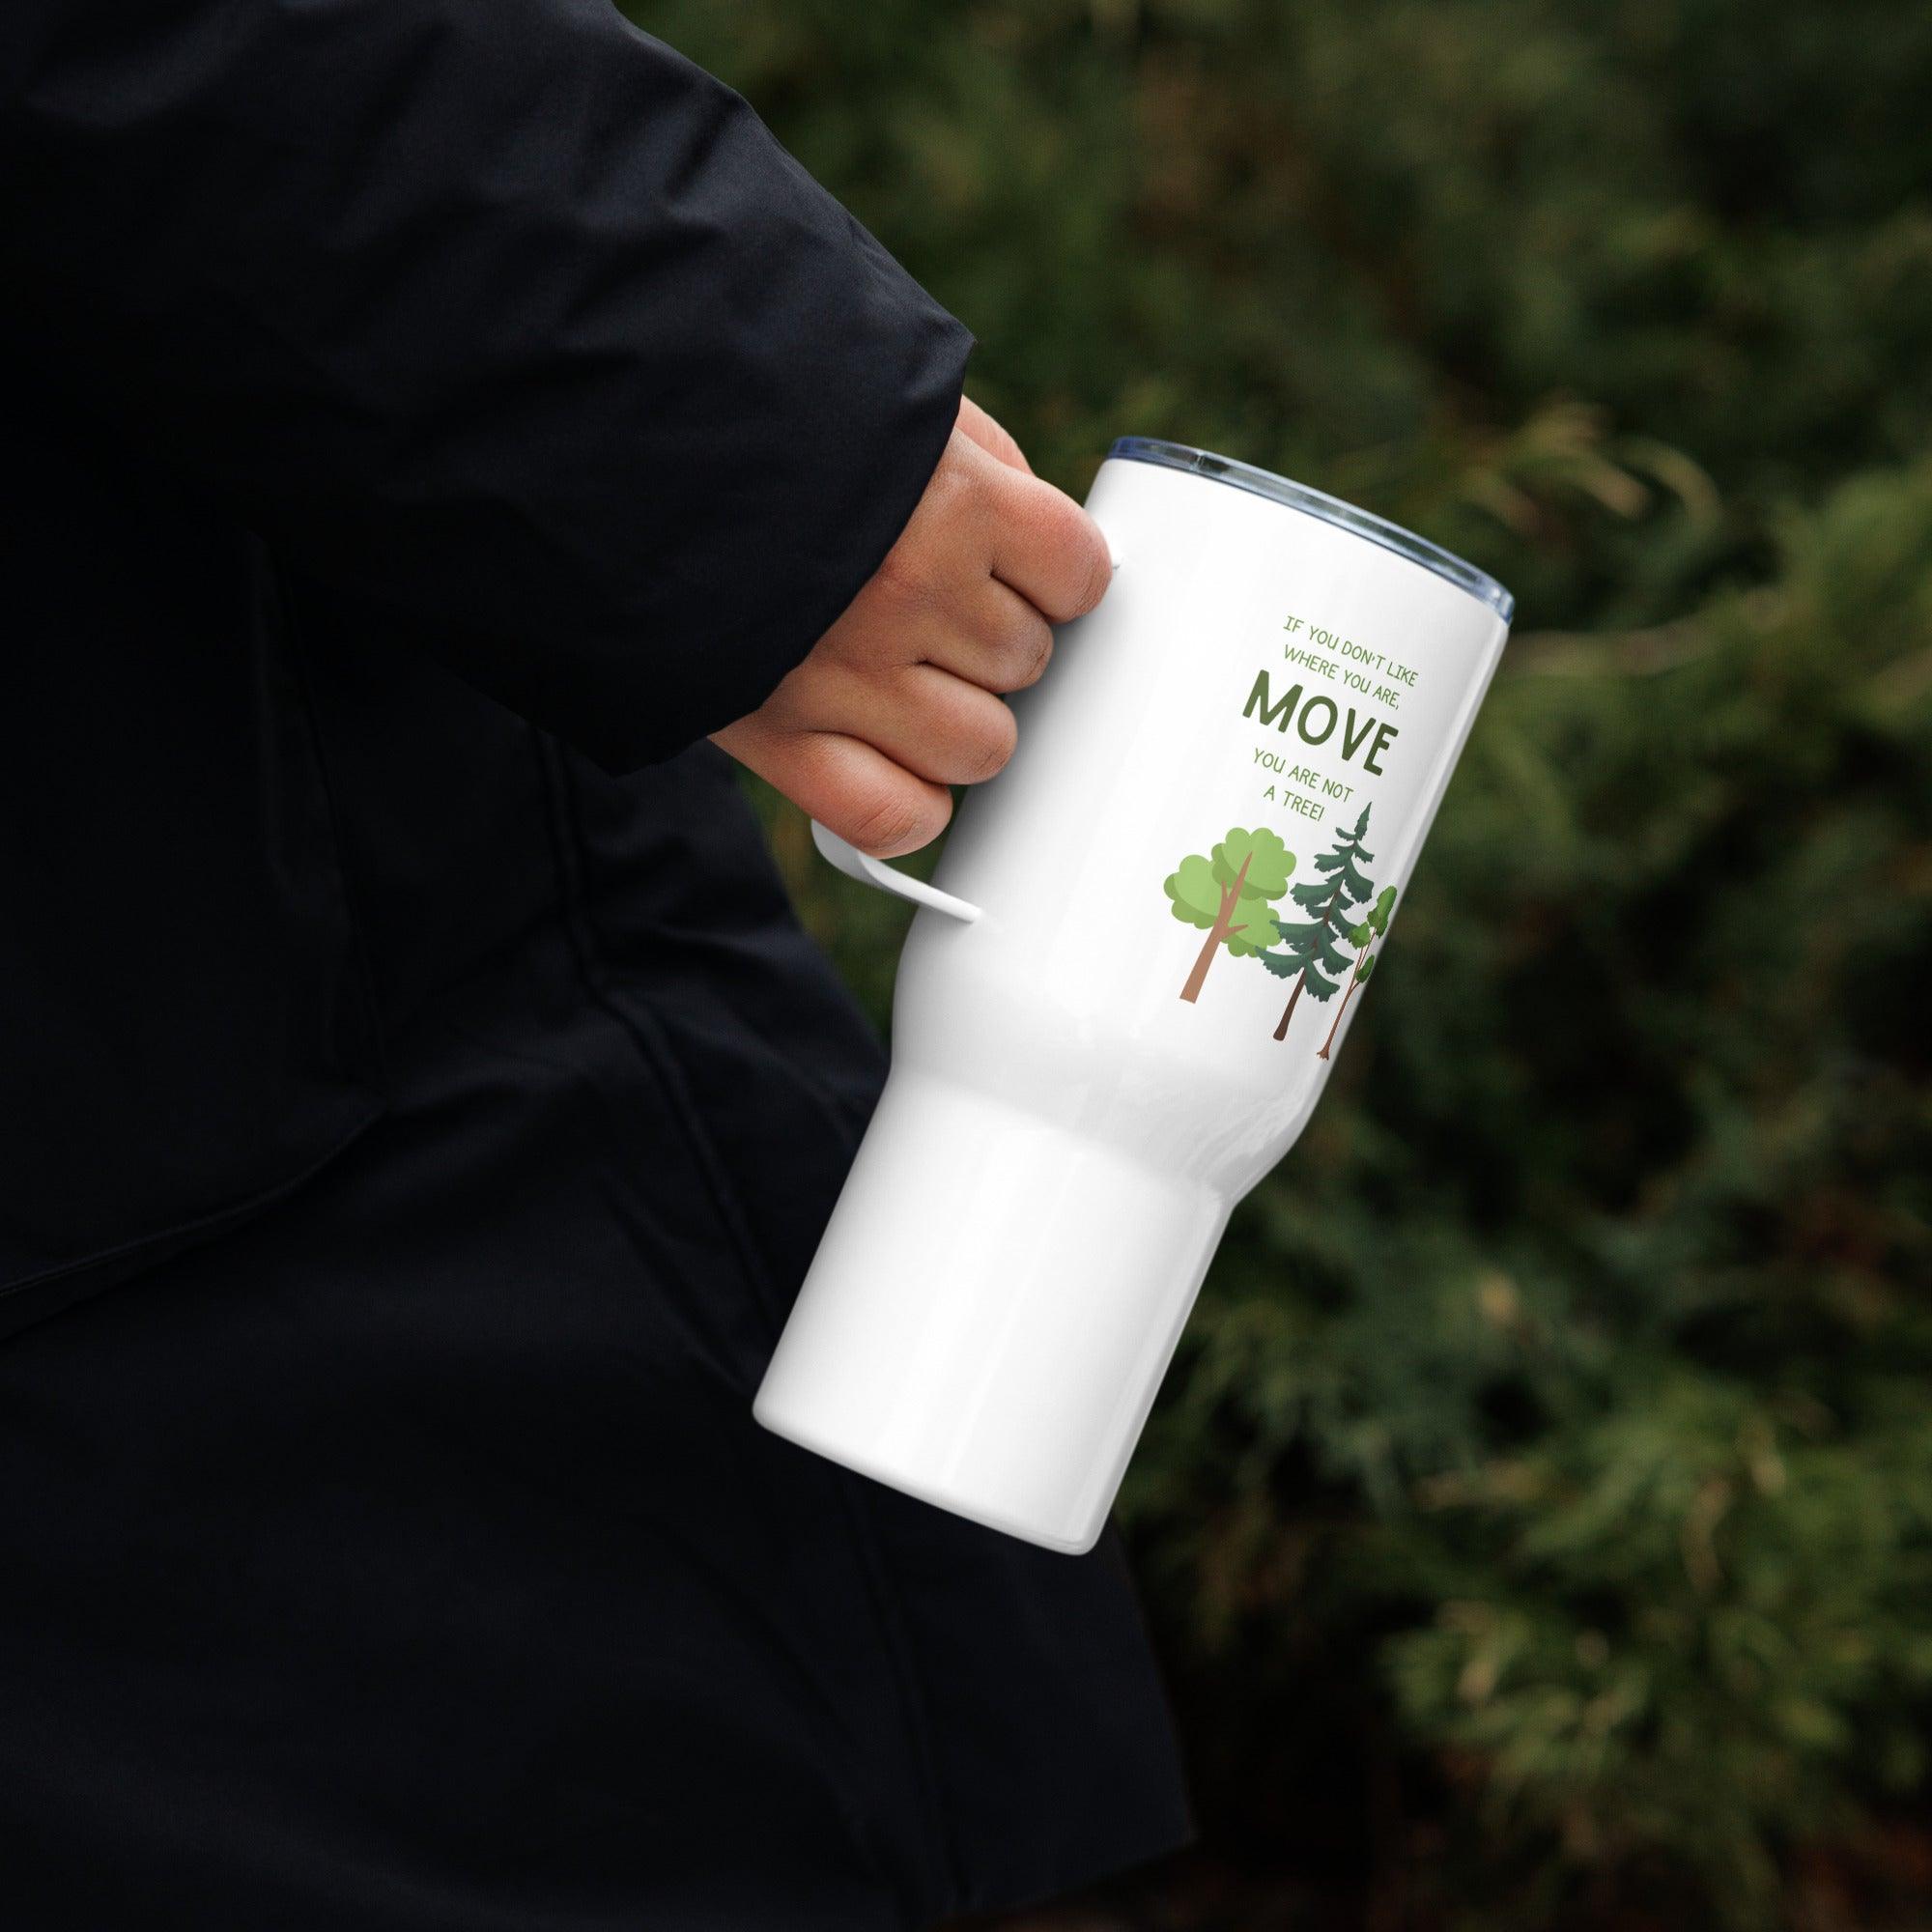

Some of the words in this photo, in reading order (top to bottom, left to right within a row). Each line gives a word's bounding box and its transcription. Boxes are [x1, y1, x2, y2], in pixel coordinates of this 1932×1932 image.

[1283, 615, 1304, 633] IF
[1309, 626, 1340, 650] YOU
[1341, 640, 1386, 669] DON'T
[1386, 662, 1419, 687] LIKE
[1284, 644, 1339, 680] WHERE
[1344, 669, 1371, 694] YOU
[1373, 686, 1400, 710] ARE,
[1242, 669, 1399, 776] MOVE
[1254, 748, 1286, 774] YOU
[1288, 765, 1321, 789] ARE
[1321, 779, 1353, 803] NOT
[1264, 785, 1275, 801] A
[1283, 790, 1325, 822] TREE!
